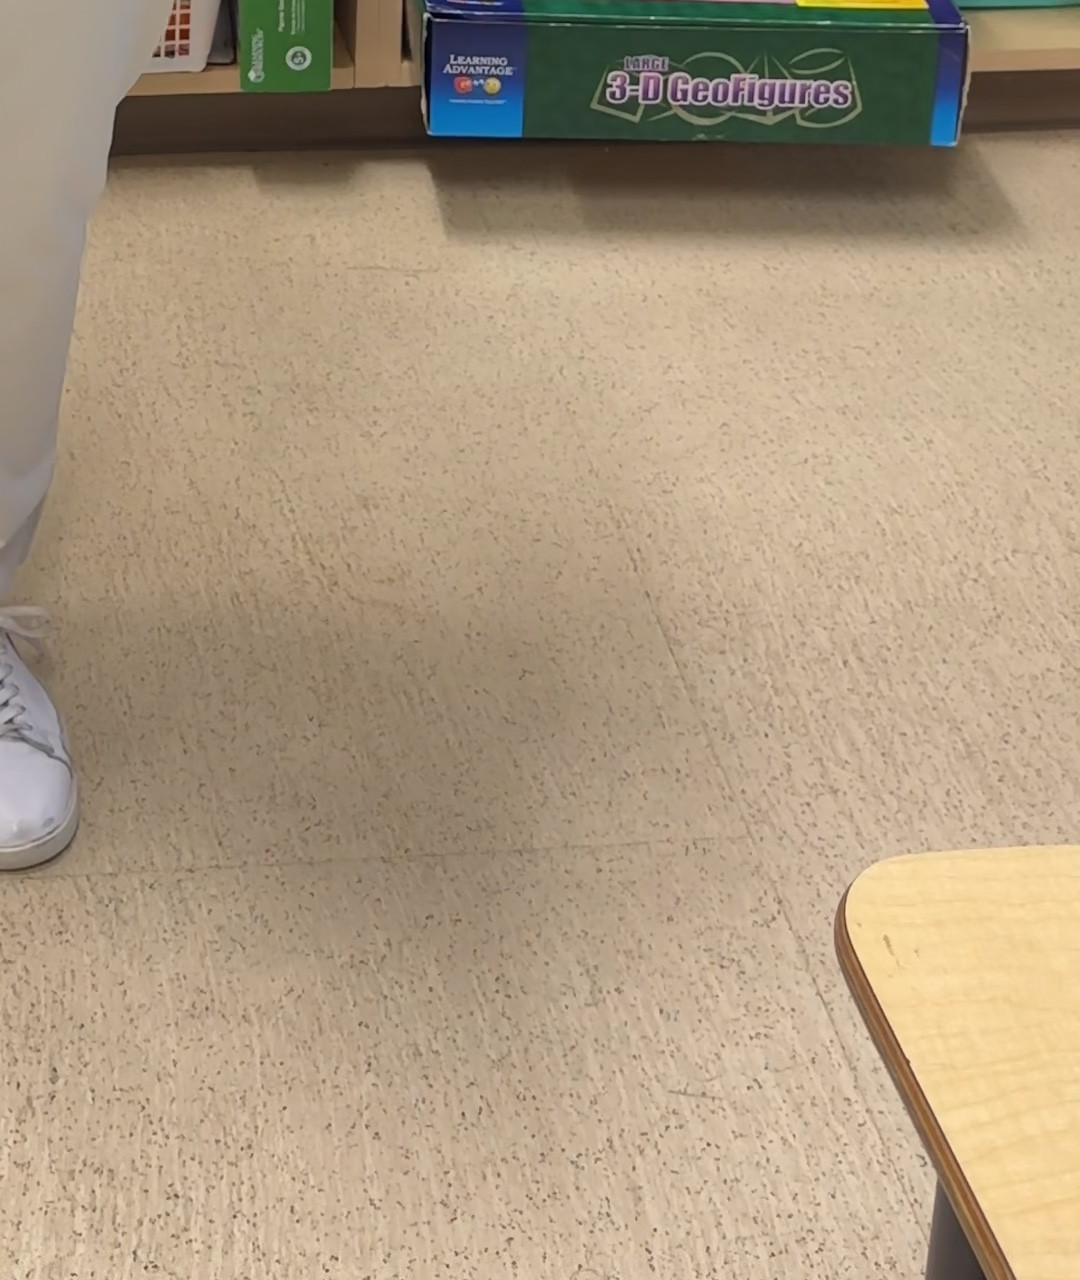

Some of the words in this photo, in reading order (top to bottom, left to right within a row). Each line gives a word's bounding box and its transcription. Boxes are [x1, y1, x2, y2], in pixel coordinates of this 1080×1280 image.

[449, 55, 508, 66] LEARNING
[624, 56, 669, 71] LARGE
[443, 64, 513, 76] ADVANTAGE
[606, 70, 664, 104] 3-D
[667, 72, 851, 111] GeoFigures
